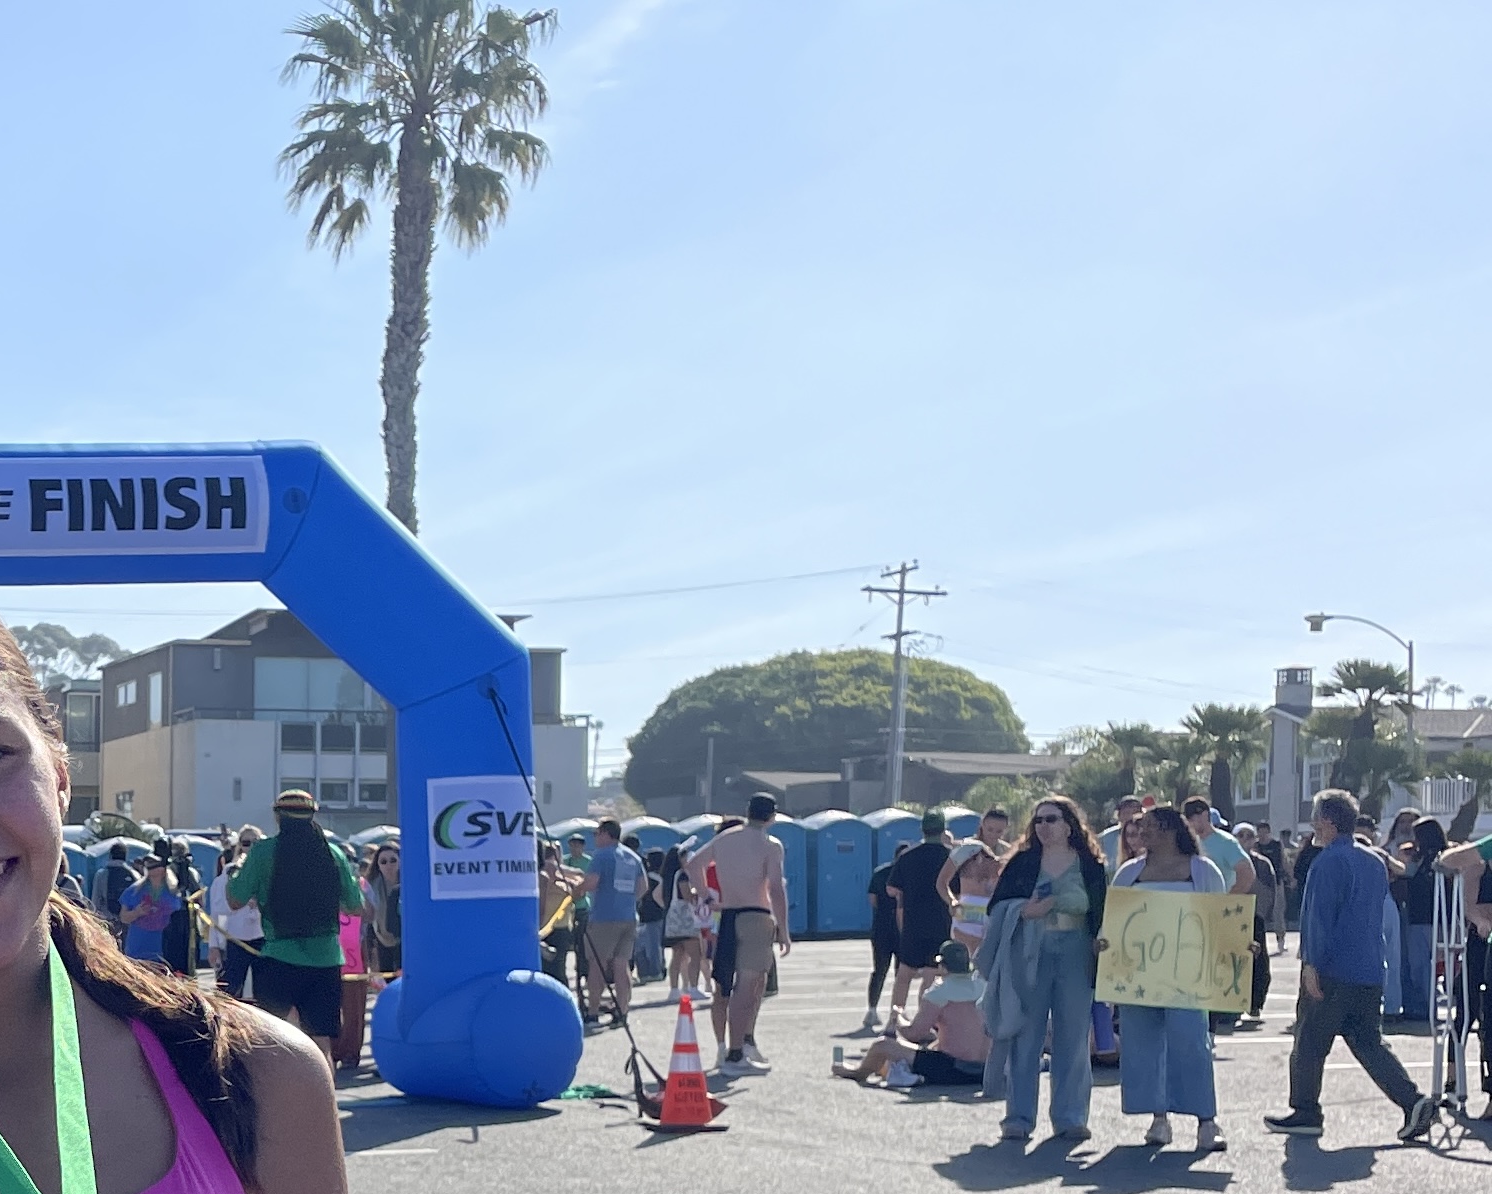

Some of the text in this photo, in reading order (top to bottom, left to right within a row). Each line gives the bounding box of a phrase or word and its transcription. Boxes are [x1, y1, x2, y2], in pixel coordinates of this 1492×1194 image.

[28, 476, 248, 533] FINISH
[463, 811, 535, 838] SVE
[433, 860, 491, 876] EVENT
